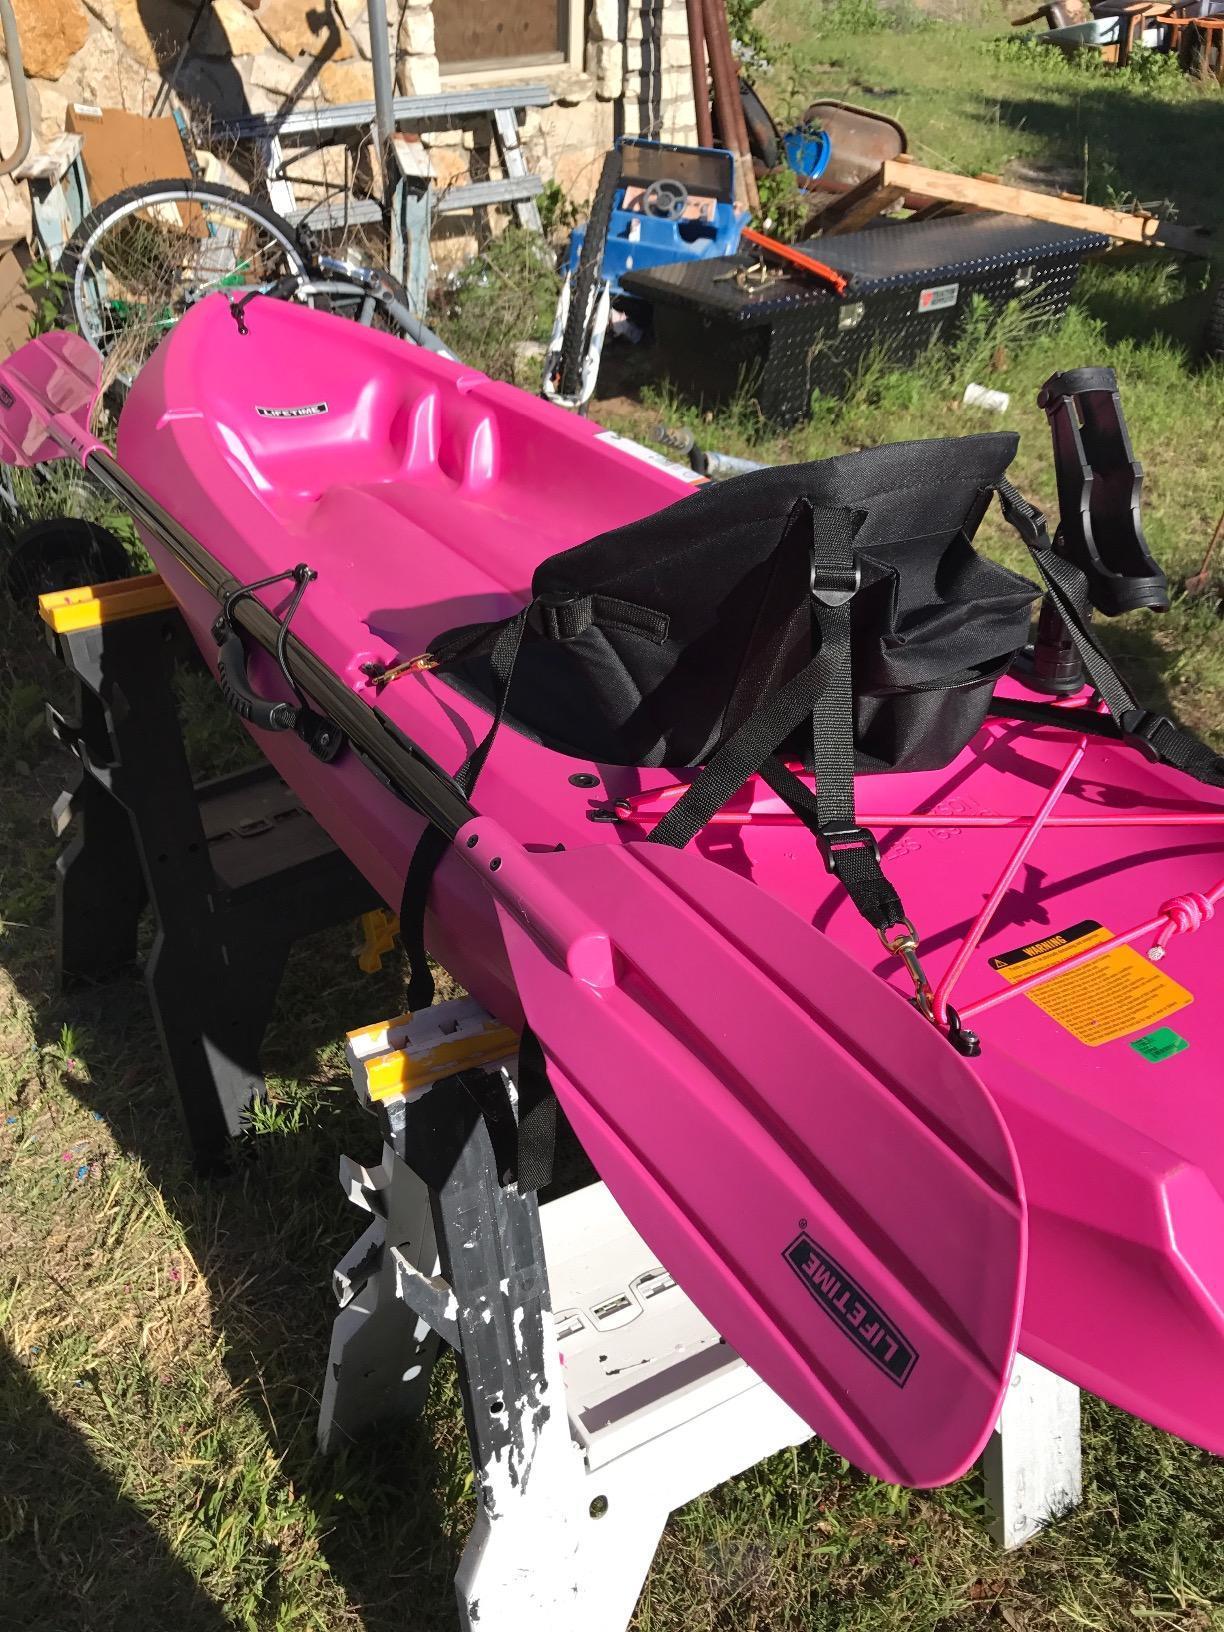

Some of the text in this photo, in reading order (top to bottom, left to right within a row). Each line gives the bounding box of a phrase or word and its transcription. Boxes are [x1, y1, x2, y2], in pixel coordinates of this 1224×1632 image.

[263, 406, 319, 417] LIFETIME
[1022, 935, 1068, 957] WARNING
[800, 1250, 901, 1363] LIFETIME
